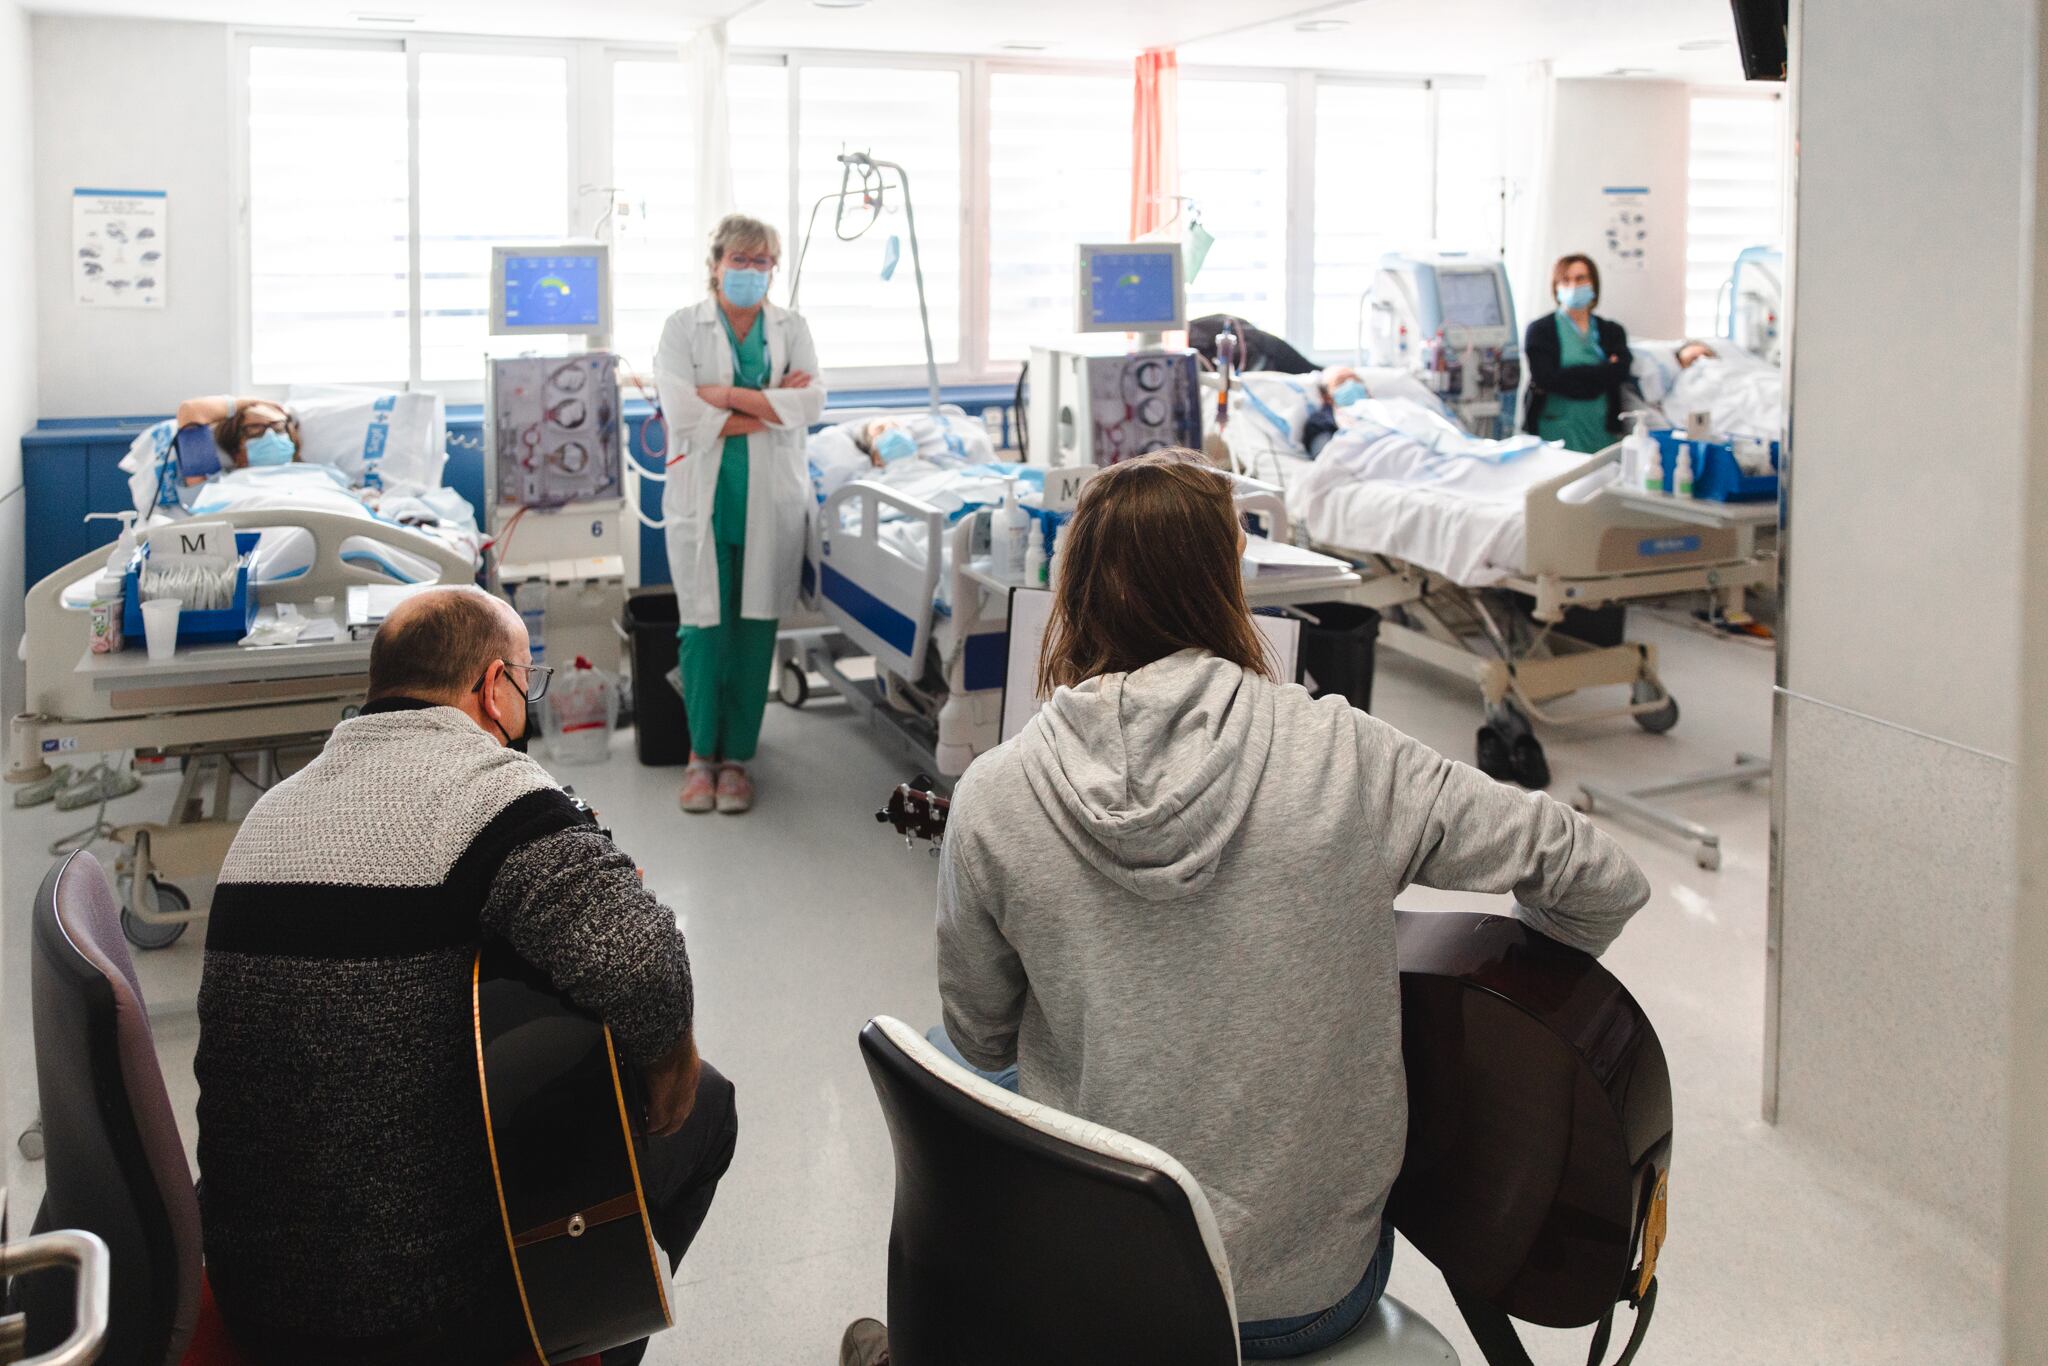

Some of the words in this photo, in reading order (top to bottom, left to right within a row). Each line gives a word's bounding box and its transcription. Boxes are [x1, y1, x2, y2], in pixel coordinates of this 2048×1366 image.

[1061, 478, 1080, 501] M
[591, 520, 603, 538] 6
[180, 533, 206, 554] M
